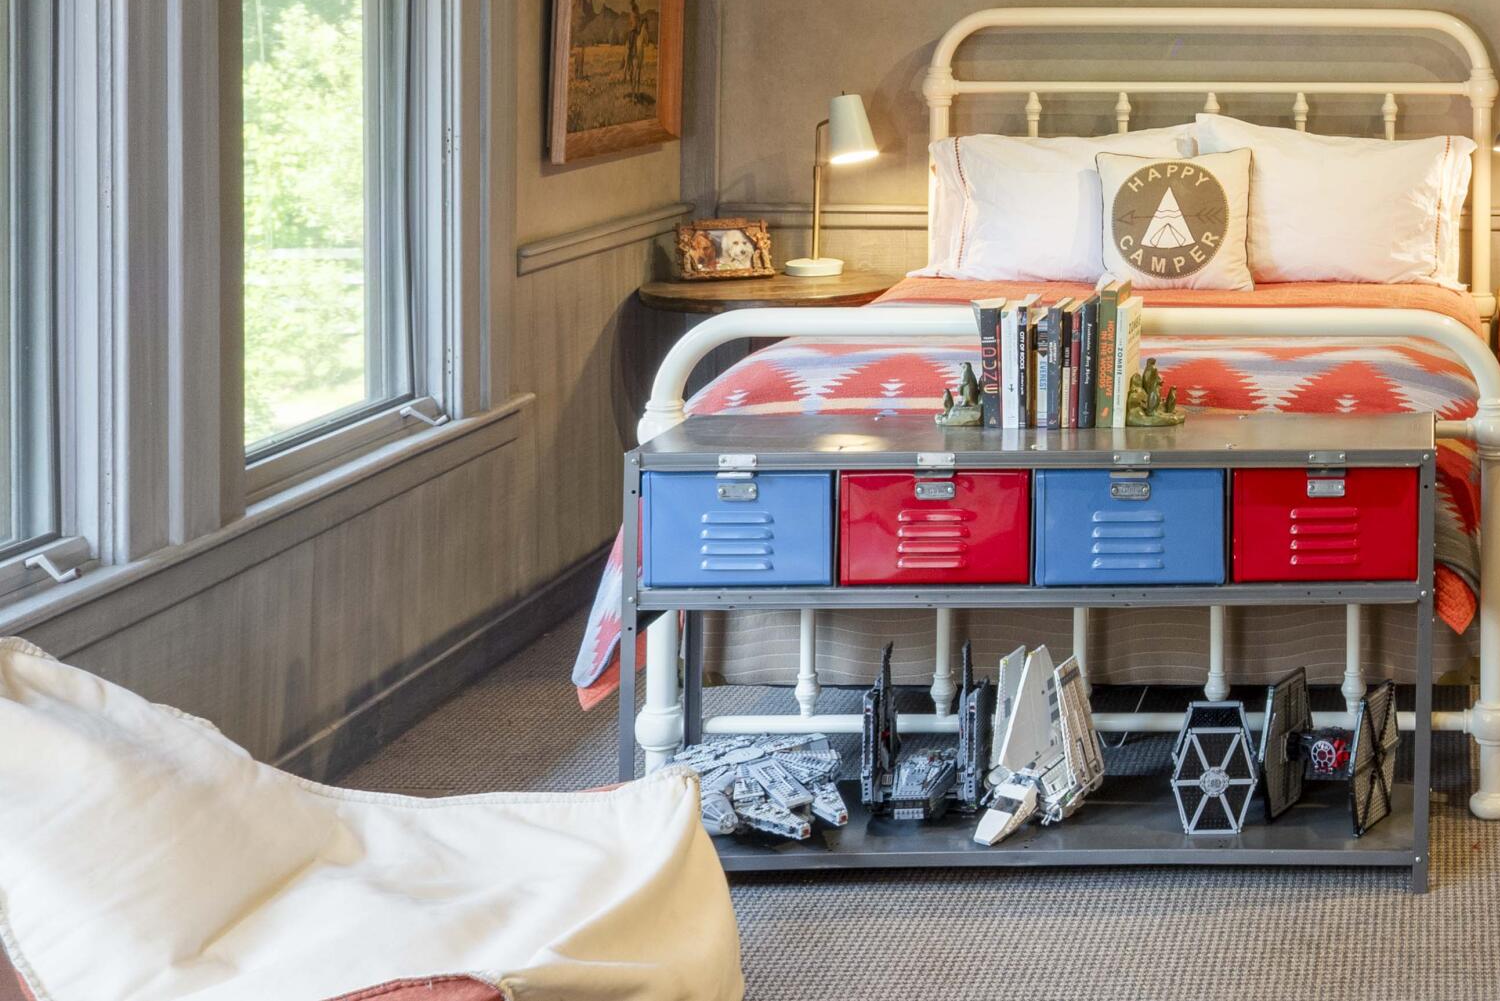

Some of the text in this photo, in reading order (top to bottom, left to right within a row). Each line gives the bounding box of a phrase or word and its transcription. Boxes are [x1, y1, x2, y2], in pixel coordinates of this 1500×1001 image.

[1127, 164, 1211, 193] HAPPY
[1119, 231, 1220, 274] CAMPER
[1101, 330, 1107, 340] IN
[1107, 320, 1115, 341] HOW
[1019, 343, 1026, 351] OF
[1107, 343, 1114, 353] TO
[982, 347, 999, 394] DUNE
[1039, 361, 1048, 391] EVEREST
[1071, 366, 1079, 385] Dracula
[1099, 358, 1107, 389] WOODS
[1105, 375, 1113, 397] ALIVE
